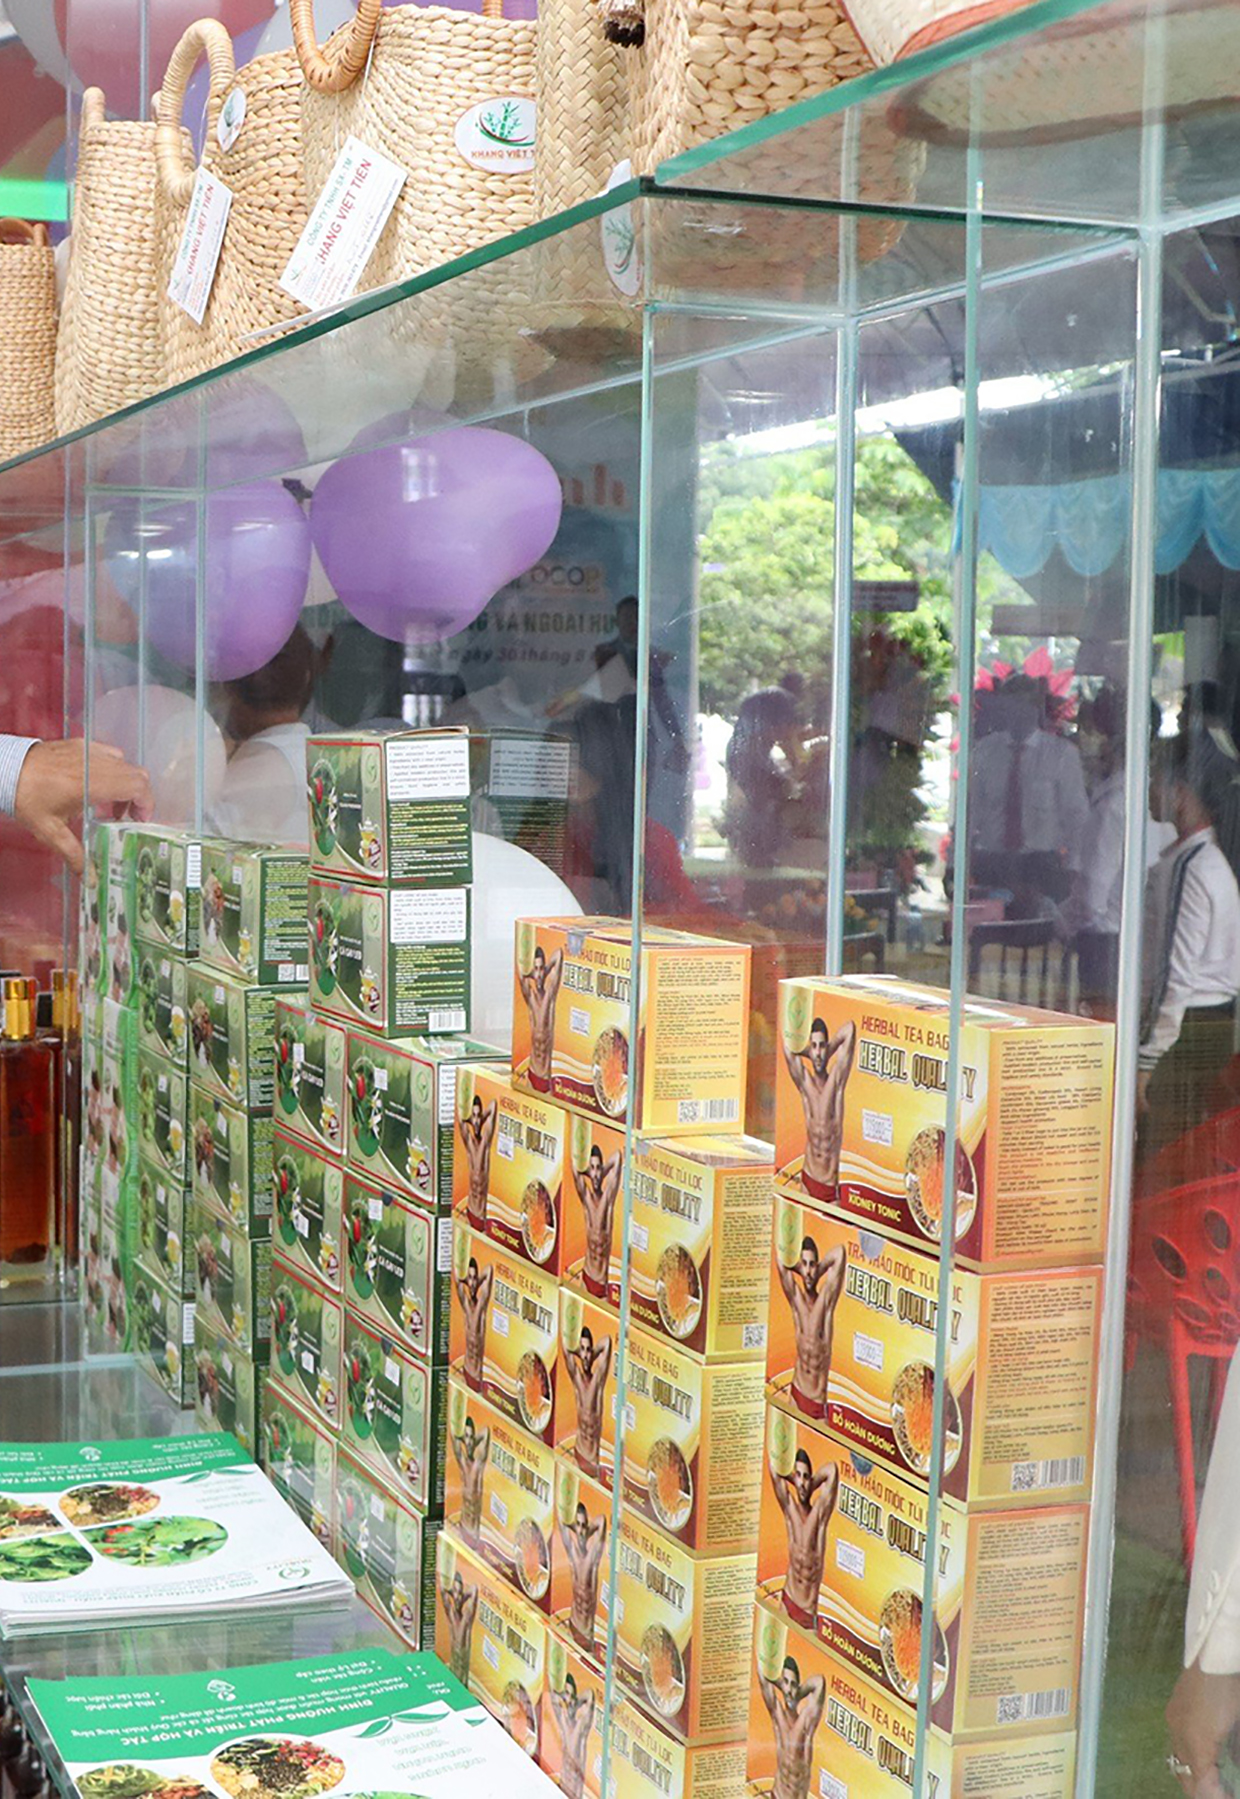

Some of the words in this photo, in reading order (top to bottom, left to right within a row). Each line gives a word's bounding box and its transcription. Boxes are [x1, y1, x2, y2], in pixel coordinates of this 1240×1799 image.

[319, 209, 328, 221] TY
[324, 187, 339, 209] TNHH
[336, 190, 356, 220] VIỆT
[861, 1015, 900, 1040] HERBAL
[903, 1025, 924, 1045] TEA
[926, 1030, 950, 1051] BAG
[858, 1039, 908, 1082] HERBAL
[526, 1126, 557, 1160] QUALITY
[662, 1183, 702, 1222] QUALITY
[847, 1194, 875, 1216] KIDNEY
[876, 1204, 902, 1223] TONIC
[846, 1264, 894, 1313] HERBAL
[919, 1271, 935, 1292] TÚI
[522, 1295, 554, 1334] QUALITY
[647, 1350, 661, 1369] TEA
[662, 1358, 679, 1380] BAG
[653, 1375, 693, 1420] QUALITY
[519, 1465, 551, 1507] QUALITY
[839, 1483, 884, 1537] HERBAL
[908, 1501, 923, 1523] TÚI
[646, 1562, 686, 1610] QUALITY
[340, 1699, 373, 1712] ĐỊNH
[370, 1682, 409, 1696] QUALITY
[205, 1719, 246, 1734] TRIỂN
[249, 1715, 283, 1727] PHÁT
[826, 1696, 874, 1757] HERBAL
[831, 1675, 868, 1714] HERBAL
[871, 1703, 889, 1730] TEA
[892, 1719, 915, 1748] BAG
[120, 1736, 149, 1746] TÁC
[151, 1731, 181, 1742] HỢP
[184, 1729, 203, 1739] VÀ
